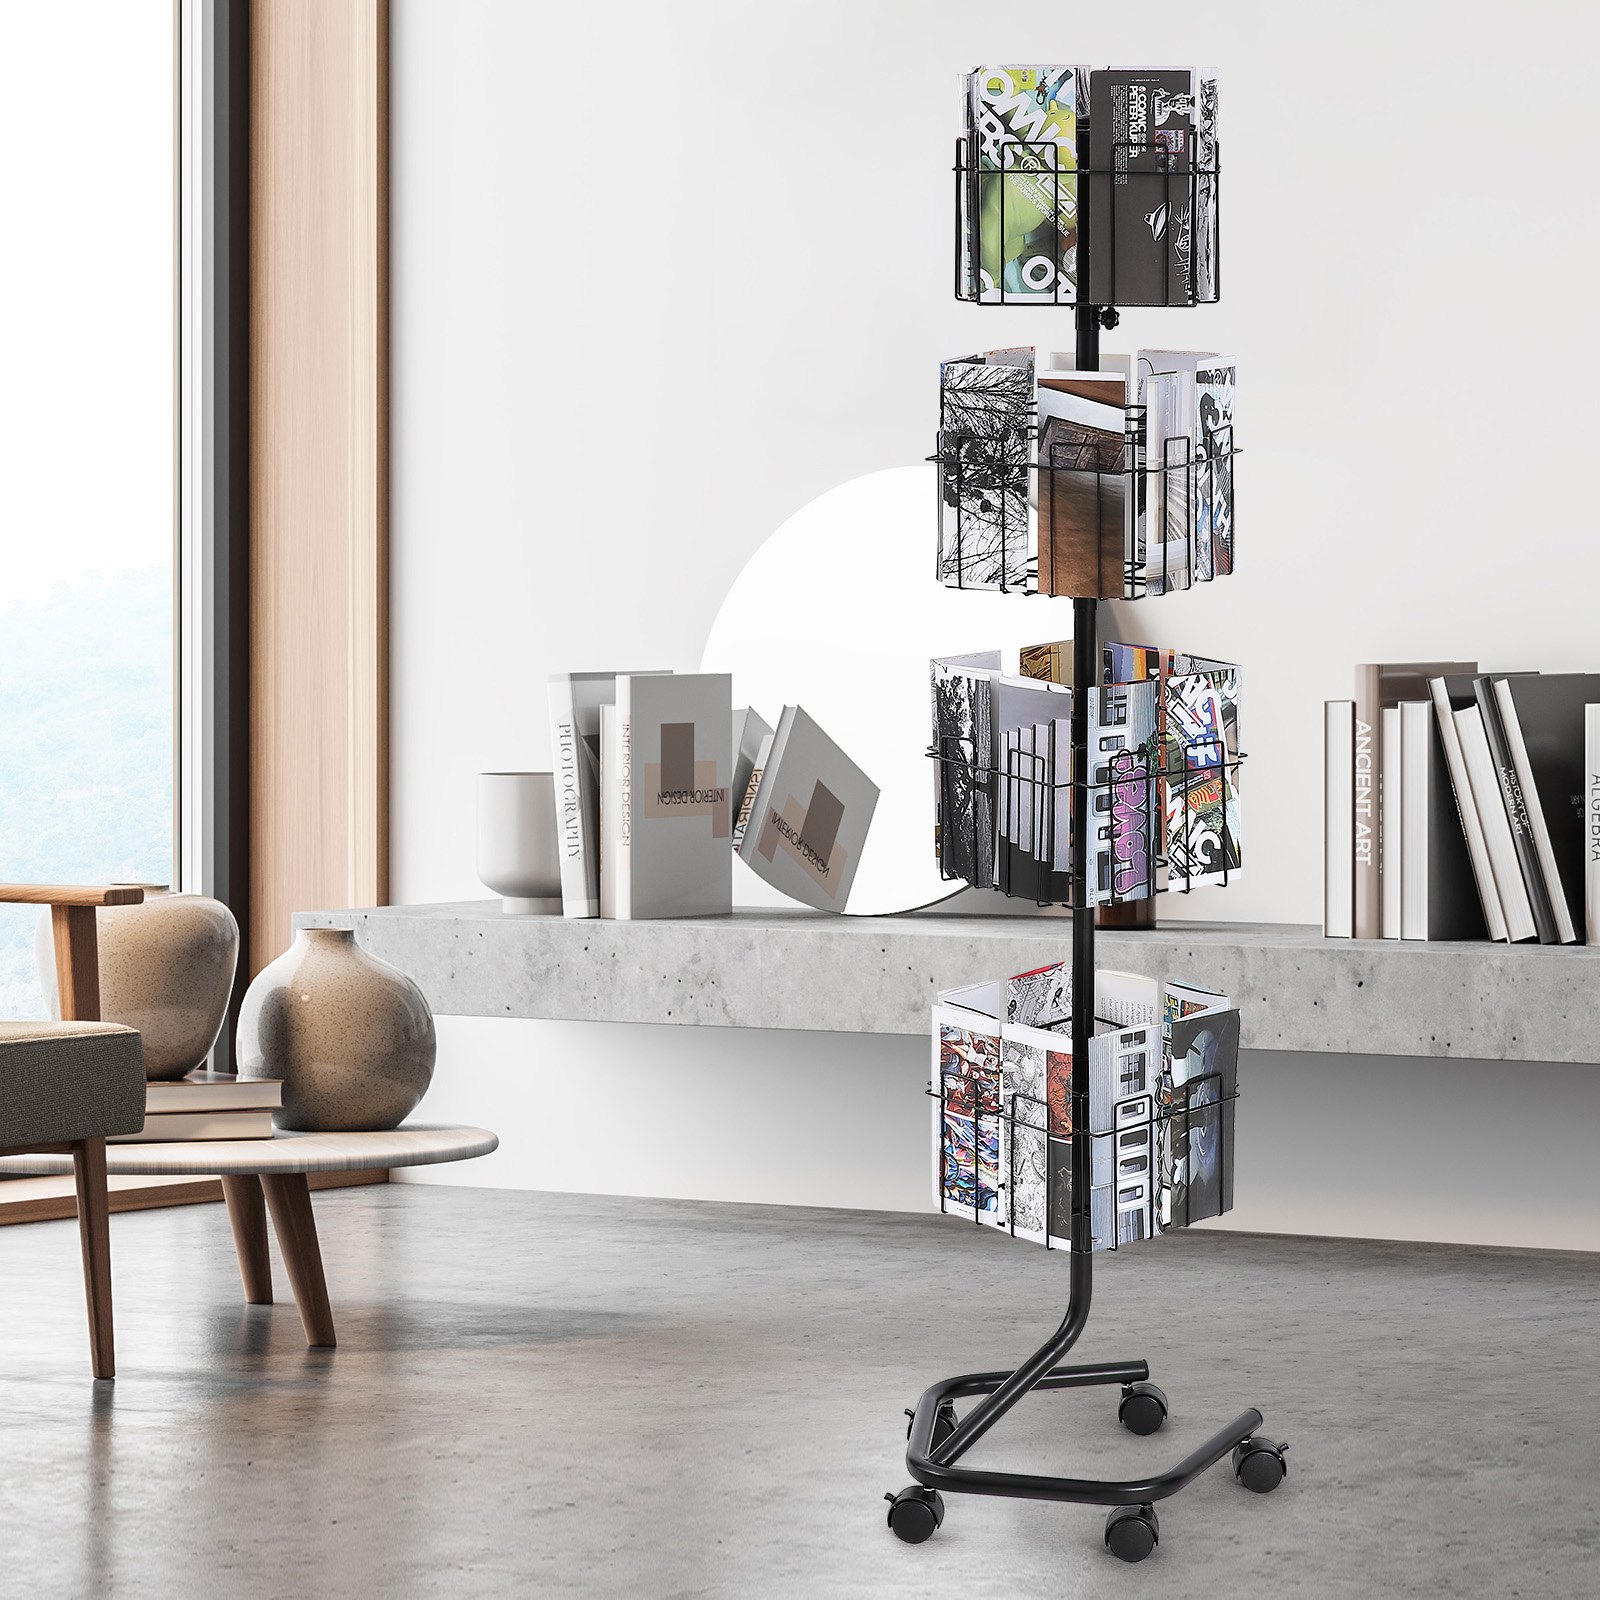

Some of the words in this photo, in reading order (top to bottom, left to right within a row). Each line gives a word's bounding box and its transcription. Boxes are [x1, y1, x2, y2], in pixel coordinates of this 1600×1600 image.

[1129, 86, 1138, 120] PETER
[1138, 94, 1147, 132] COMIC
[1016, 183, 1037, 204] COMICS
[1035, 202, 1055, 222] WORLD
[622, 724, 630, 787] INTERIOR
[1355, 719, 1371, 817] ANCIENT
[558, 723, 580, 860] PHOTOGRAPHY
[657, 790, 688, 806] DESIGN
[690, 788, 725, 804] INTERIOR
[1499, 766, 1517, 813] MODERN
[1512, 815, 1522, 835] ART
[1508, 769, 1523, 810] HISTORY
[622, 792, 630, 846] DESIGN
[1355, 821, 1371, 865] ART
